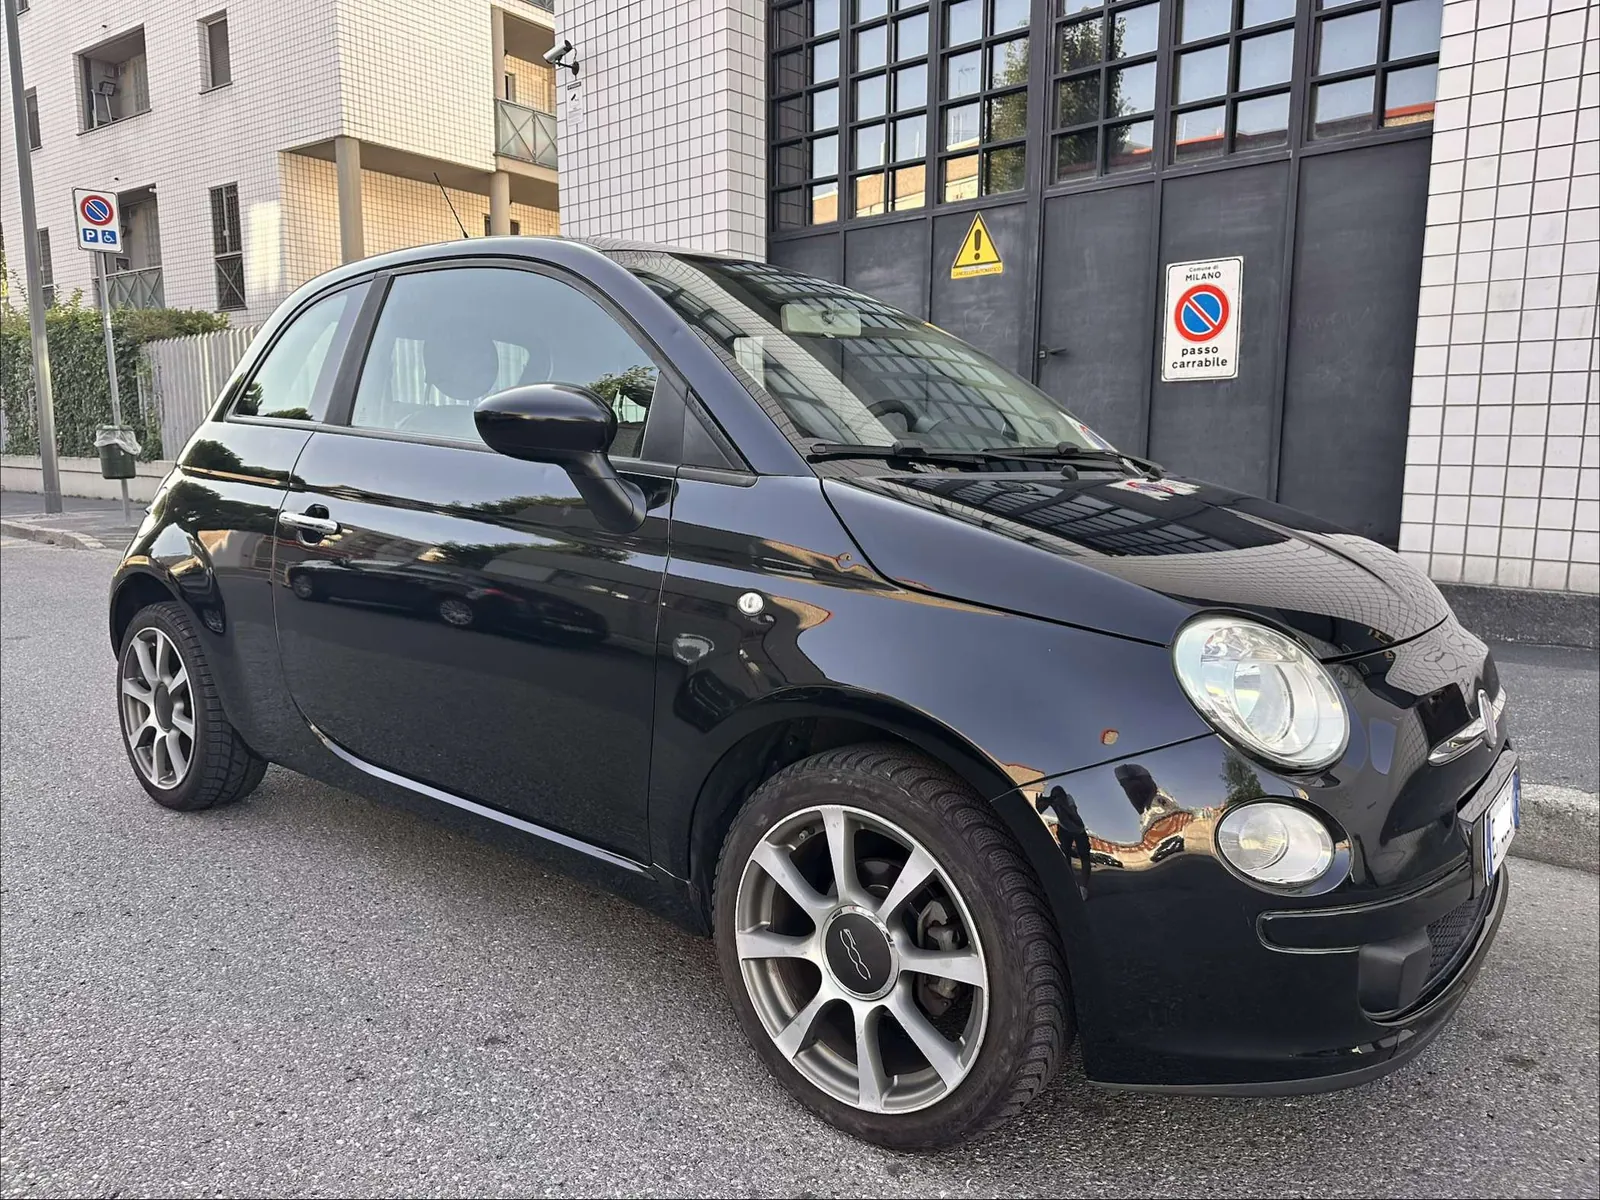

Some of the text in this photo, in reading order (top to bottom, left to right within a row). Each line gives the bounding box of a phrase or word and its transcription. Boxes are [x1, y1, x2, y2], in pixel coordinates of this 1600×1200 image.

[86, 230, 95, 241] P
[1189, 265, 1211, 273] Comune
[1185, 271, 1222, 281] MILANO
[1181, 346, 1219, 357] passo
[1172, 357, 1228, 369] carrabile
